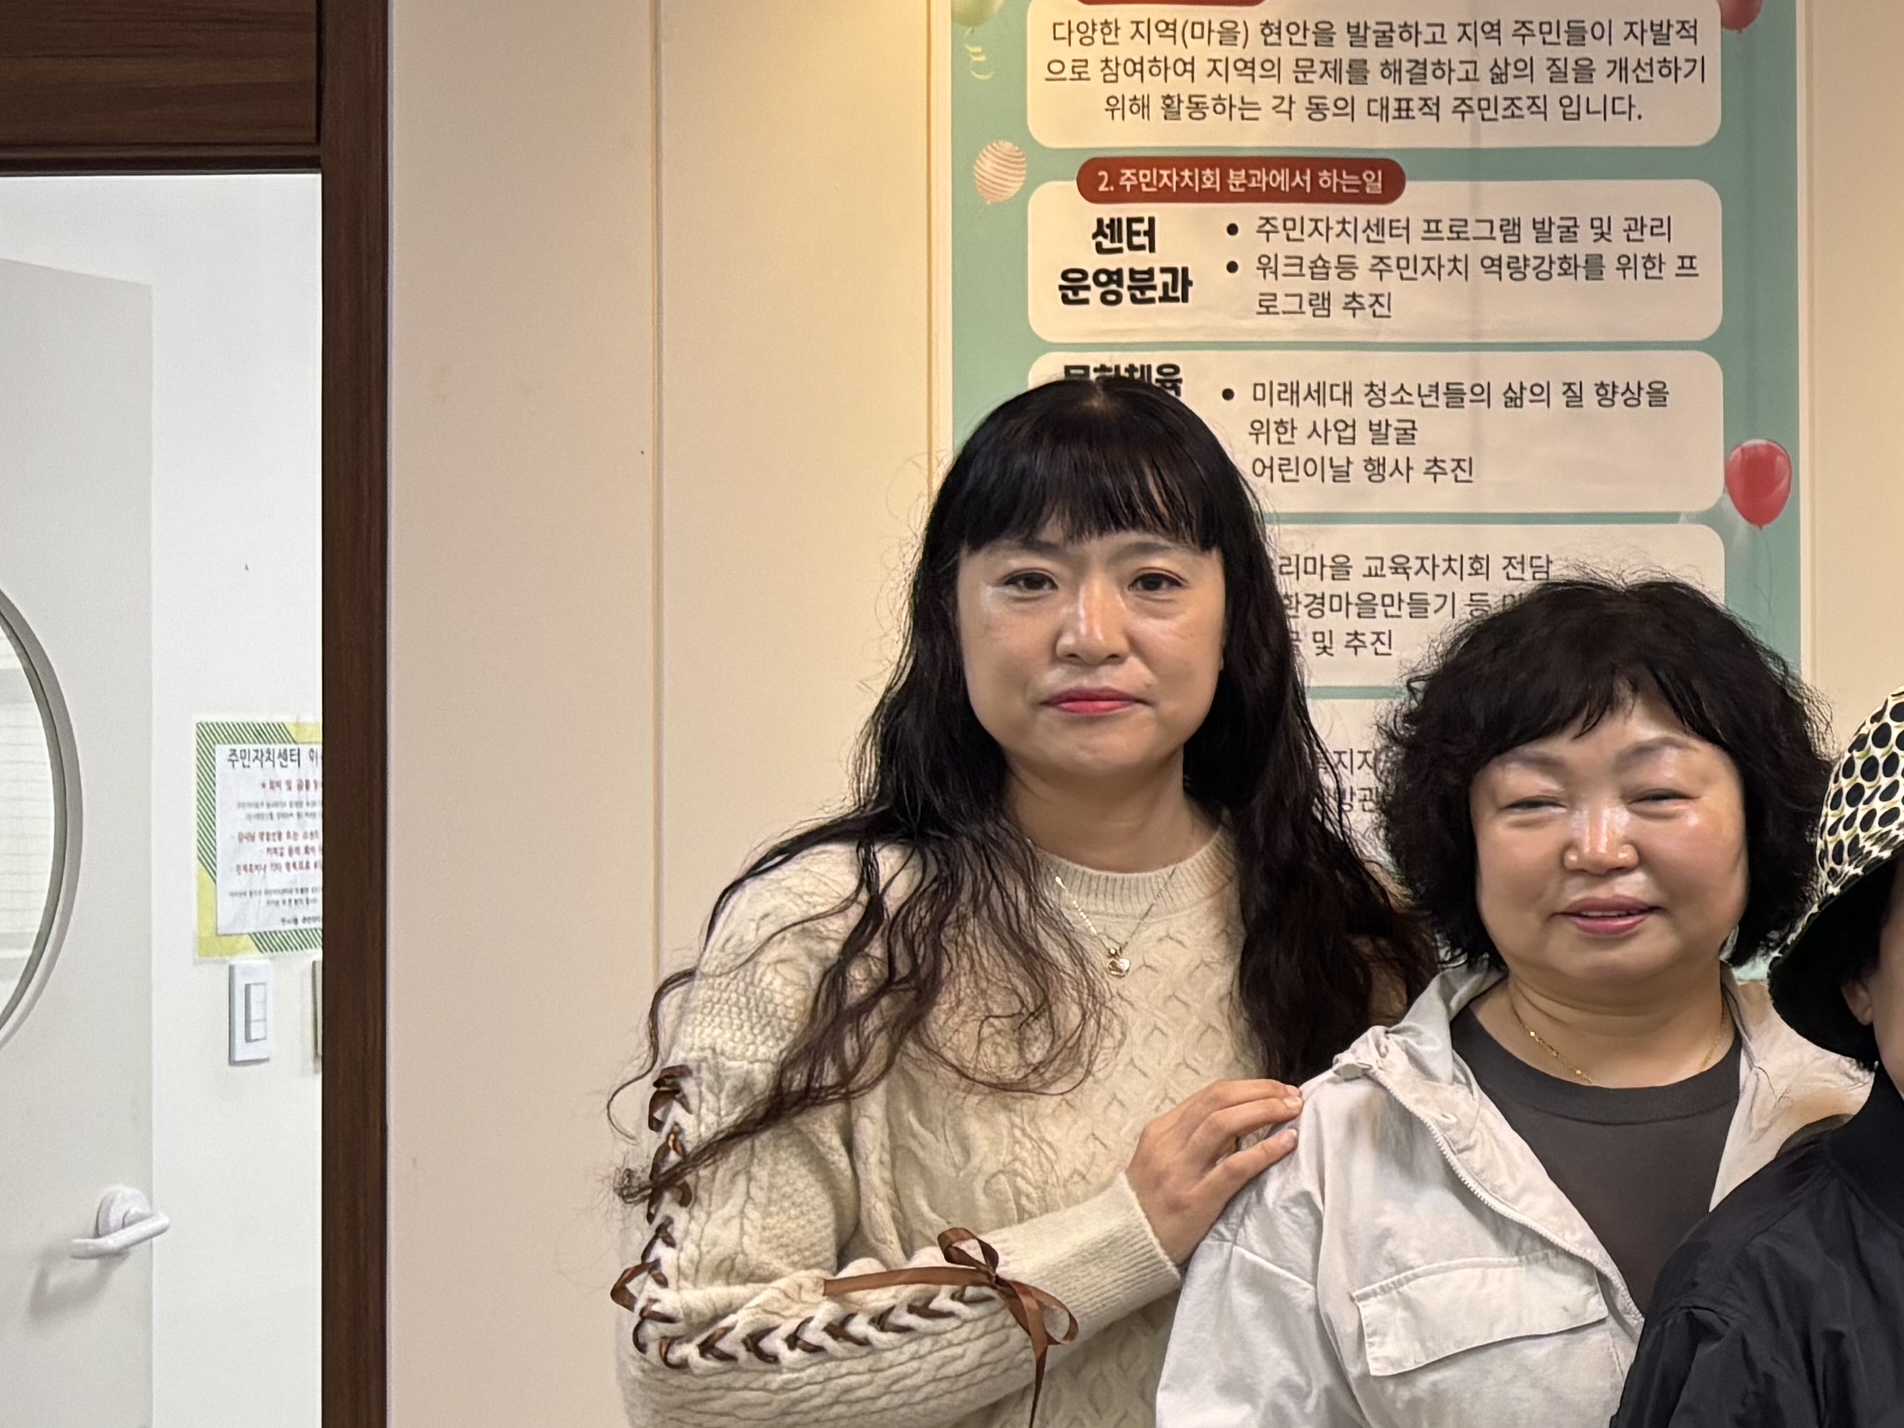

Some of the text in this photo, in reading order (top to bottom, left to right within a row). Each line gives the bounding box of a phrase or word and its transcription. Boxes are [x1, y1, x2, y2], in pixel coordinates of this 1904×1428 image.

[1052, 18, 1699, 49] 다양한 지역(마을) 현안을 발굴하고 지역 주민들이 자발적
[1044, 56, 1706, 85] 으로 참여하여 지역의 문제를 해결하고 삶의 질을 개선하기
[1104, 93, 1643, 123] 위해 활동하는 각 동의 대표적 주민조직 입니다.
[1098, 168, 1383, 194] 2. 주민자치회 분과에서 하는일
[1091, 216, 1156, 255] 센터
[1255, 215, 1673, 244] 주민자치센터 프로그램 발굴 및 관리
[1255, 253, 1700, 282] 워크숍등 주민자치 역량강화를 위한 프
[1058, 265, 1194, 307] 운영분과
[1255, 291, 1393, 319] 로그램 추진
[1252, 380, 1670, 409] 미래세대 청소년들의 삶의 질 향상을
[1248, 418, 1418, 446] 위한 사업 발굴
[1252, 456, 1475, 484] 어린이날 행사 추진
[1278, 553, 1553, 582] 리마을 교육자치회 전담
[1284, 591, 1457, 619] 환경마을만들기
[1311, 630, 1335, 656] 및
[1343, 630, 1393, 656] 추진
[227, 747, 301, 769] 주민자치센터
